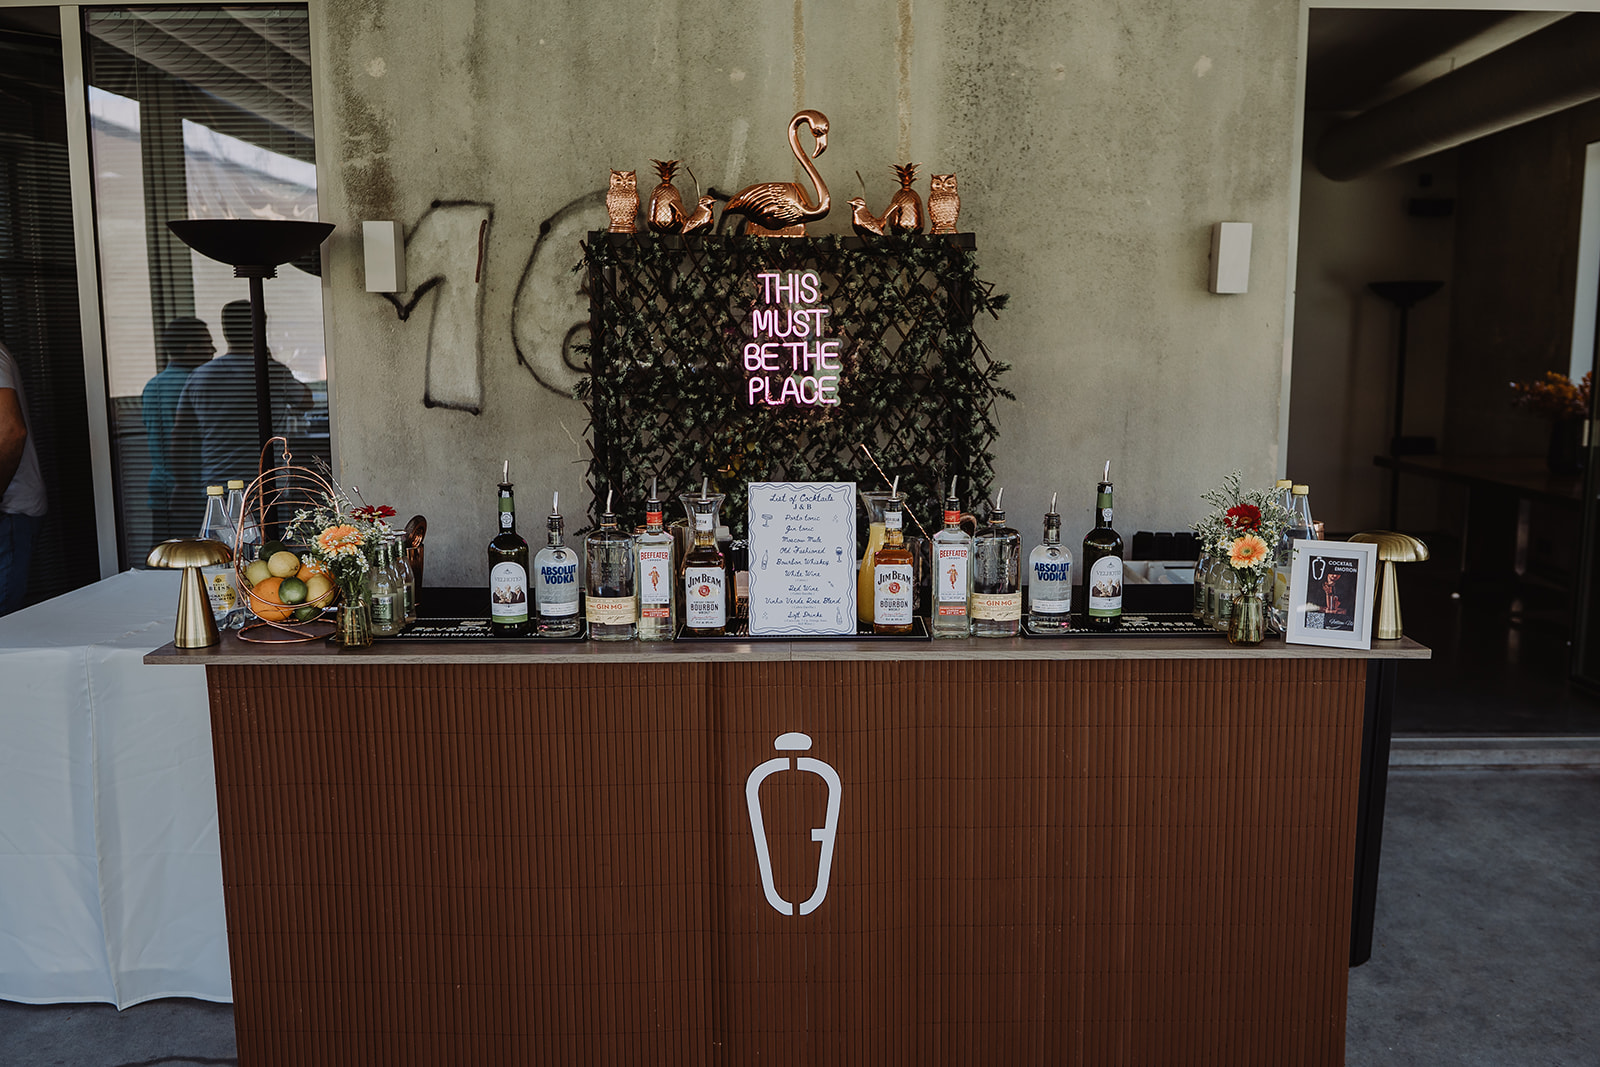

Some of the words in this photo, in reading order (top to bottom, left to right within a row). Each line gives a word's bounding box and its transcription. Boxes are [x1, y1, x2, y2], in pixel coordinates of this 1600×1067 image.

[757, 273, 819, 304] THIS
[752, 309, 829, 338] MUST
[744, 342, 780, 371] BE
[782, 341, 840, 372] THE
[748, 376, 838, 406] PLACE
[769, 493, 786, 502] List
[789, 494, 797, 504] of
[800, 493, 835, 502] Cocktails
[784, 525, 796, 534] Gin
[640, 552, 668, 560] BEEFEATER
[940, 549, 967, 558] BEEFEATER
[541, 564, 577, 576] ABSOLUT
[1034, 562, 1070, 572] ABSOLUT
[544, 574, 575, 584] VODKA
[688, 576, 701, 588] JIM
[701, 574, 721, 588] BEAM
[878, 573, 891, 585] JIM
[892, 570, 911, 584] BEAM
[1038, 572, 1067, 581] VODKA
